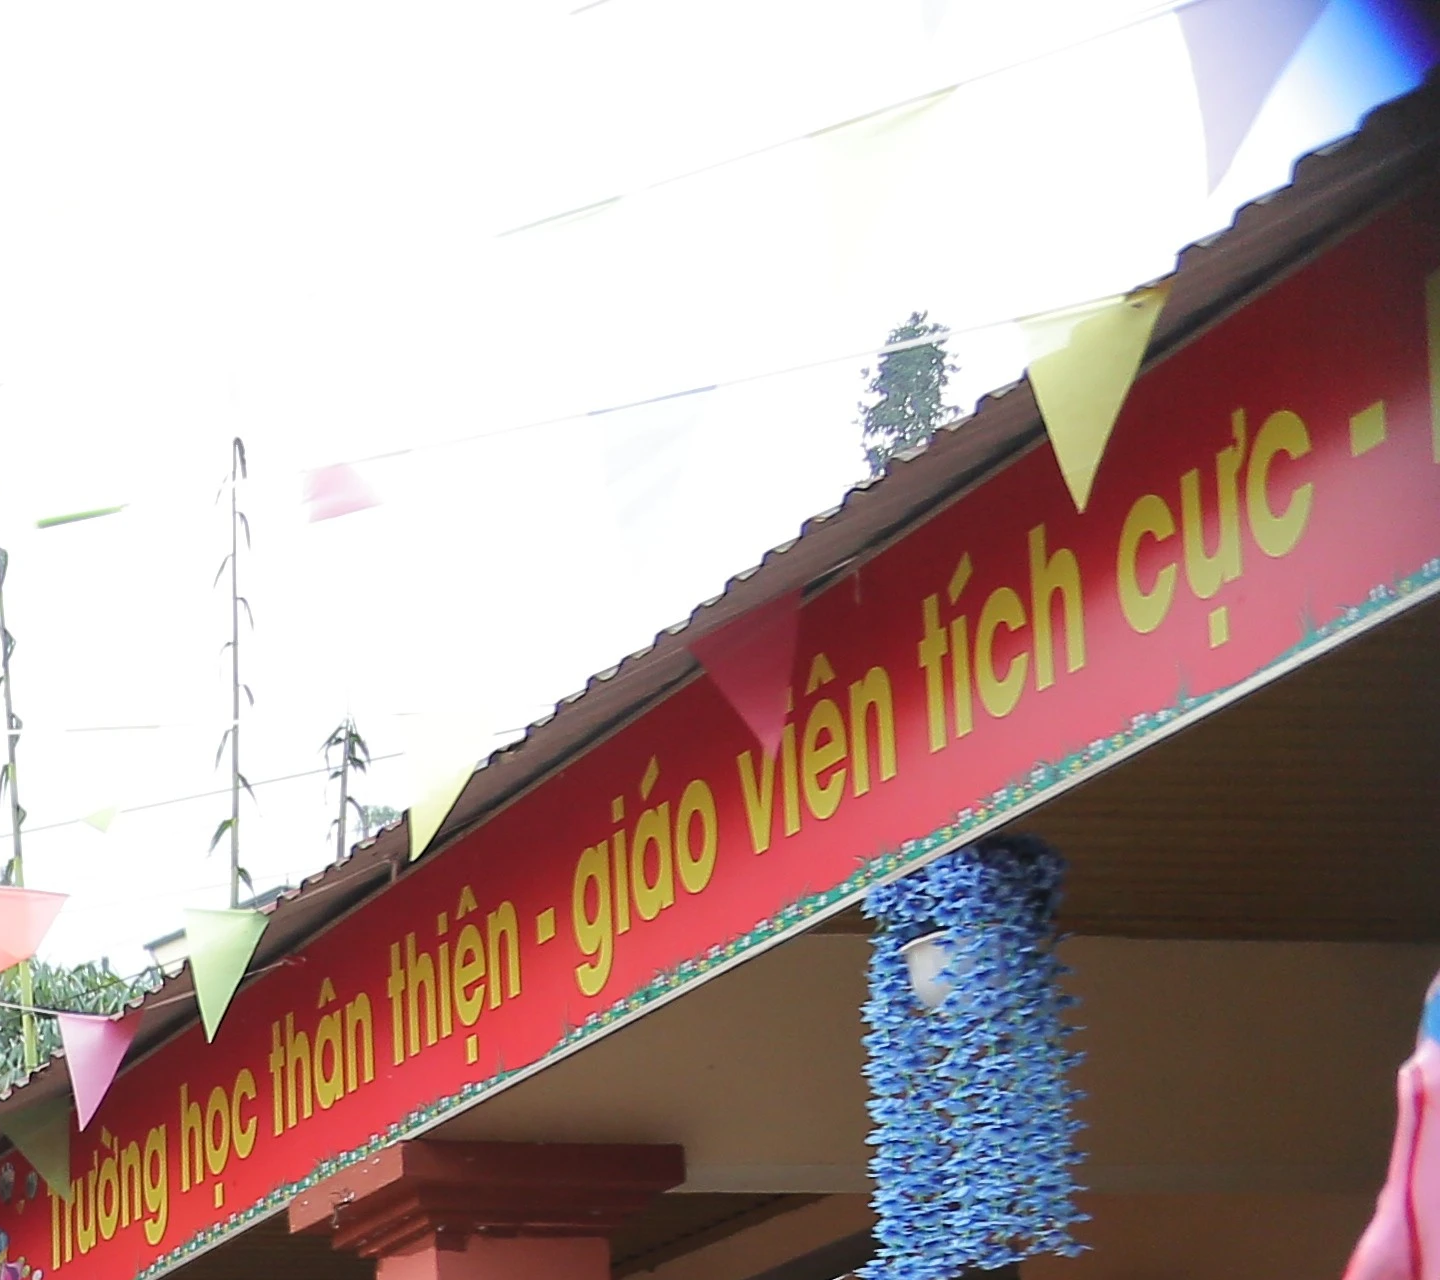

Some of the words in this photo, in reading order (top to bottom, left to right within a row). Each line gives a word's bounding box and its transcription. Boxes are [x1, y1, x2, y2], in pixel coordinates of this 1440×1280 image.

[180, 1066, 258, 1209] học
[269, 978, 376, 1137] thân
[388, 885, 521, 1066] thiện
[572, 754, 718, 997] giáo
[737, 652, 898, 856] viên
[917, 523, 1086, 754] tích
[1116, 407, 1315, 649] cực
